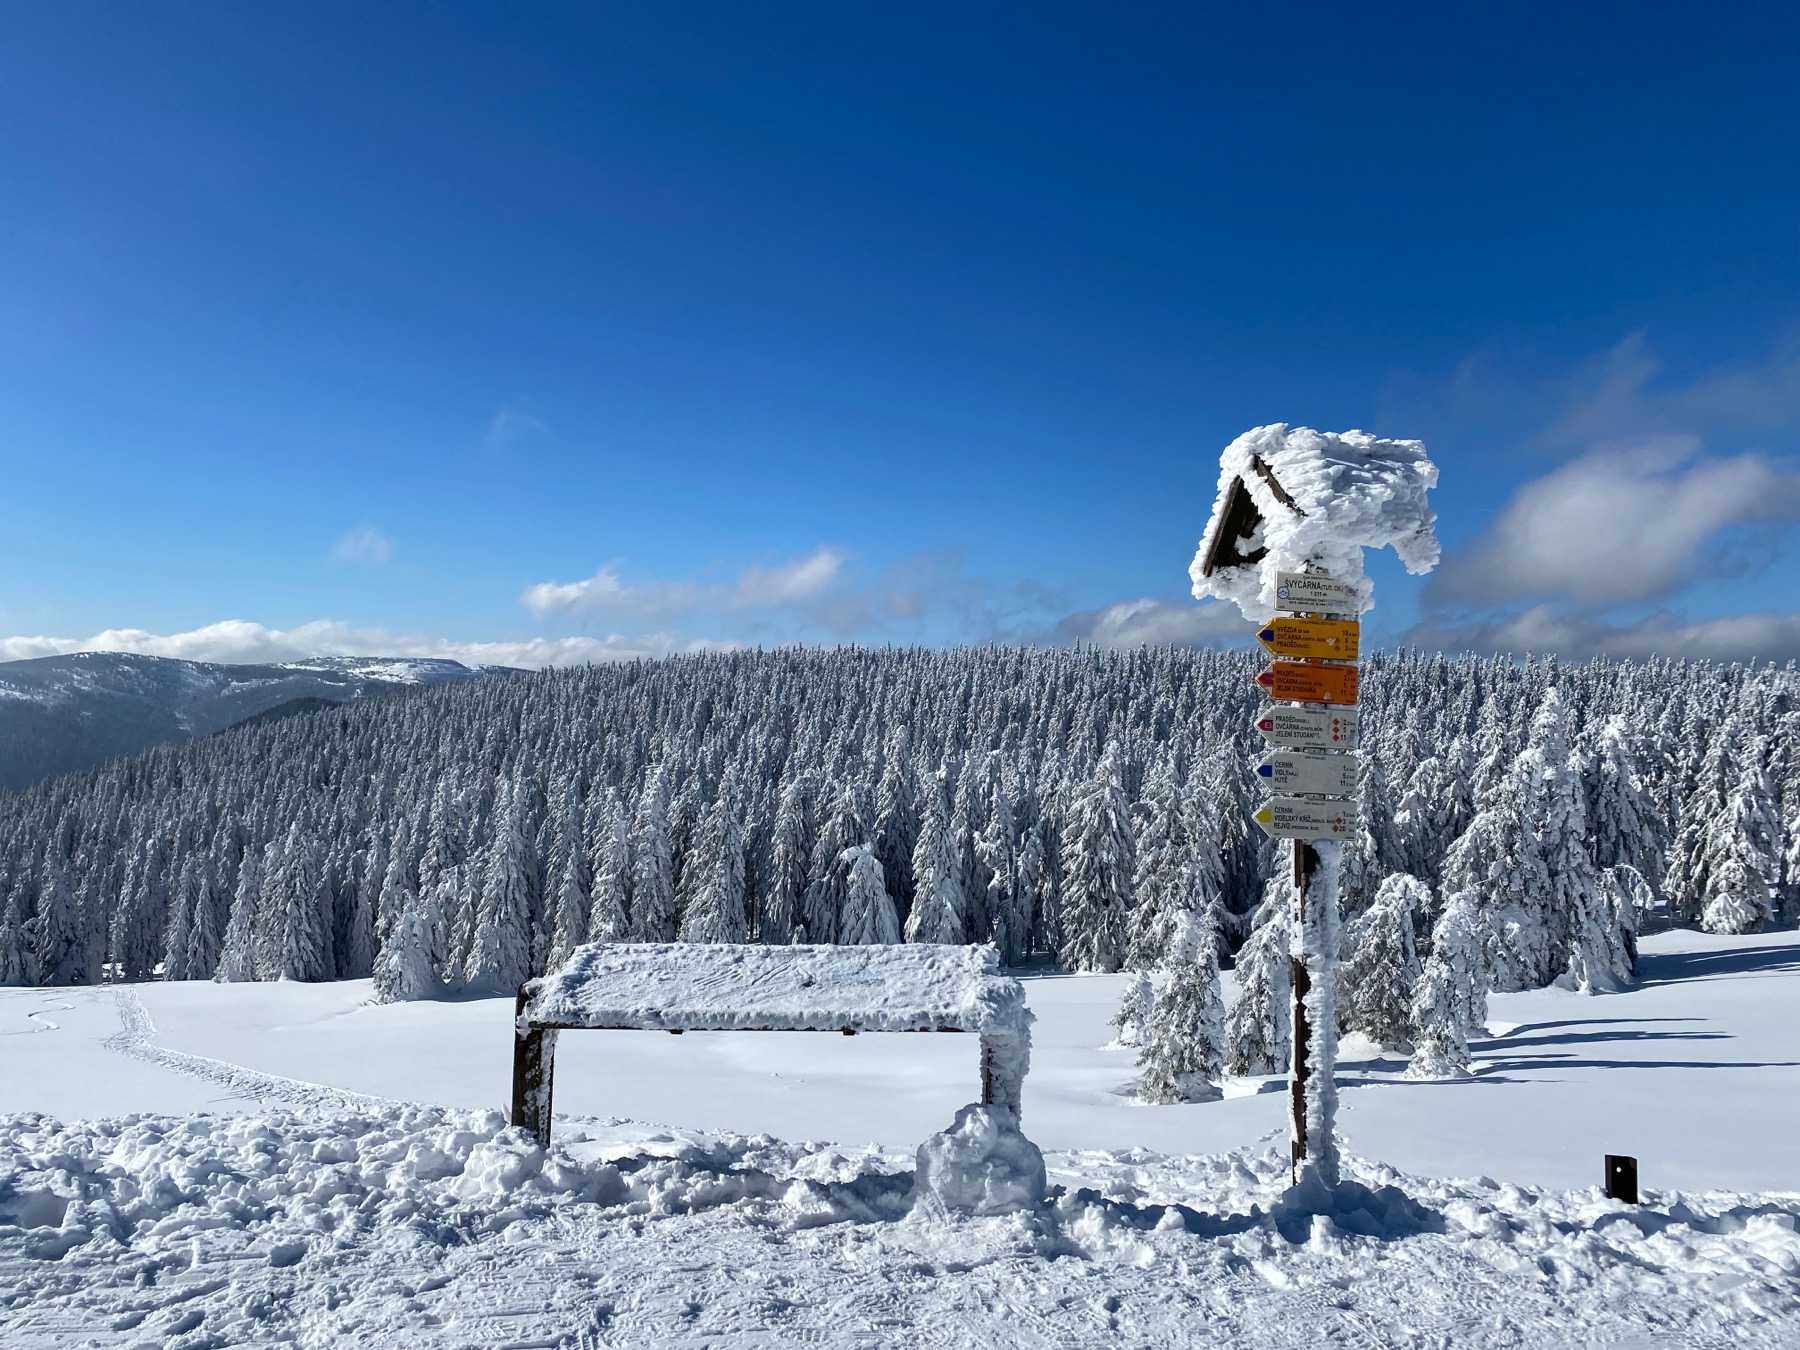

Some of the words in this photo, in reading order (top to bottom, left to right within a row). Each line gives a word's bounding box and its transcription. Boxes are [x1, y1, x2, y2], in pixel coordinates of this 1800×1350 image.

[1285, 577, 1320, 589] ŠVÝCÁRNA
[1277, 632, 1301, 640] OVČÁRNA
[1276, 714, 1296, 722] PRADĚD
[1275, 760, 1293, 768] ČERNÍK
